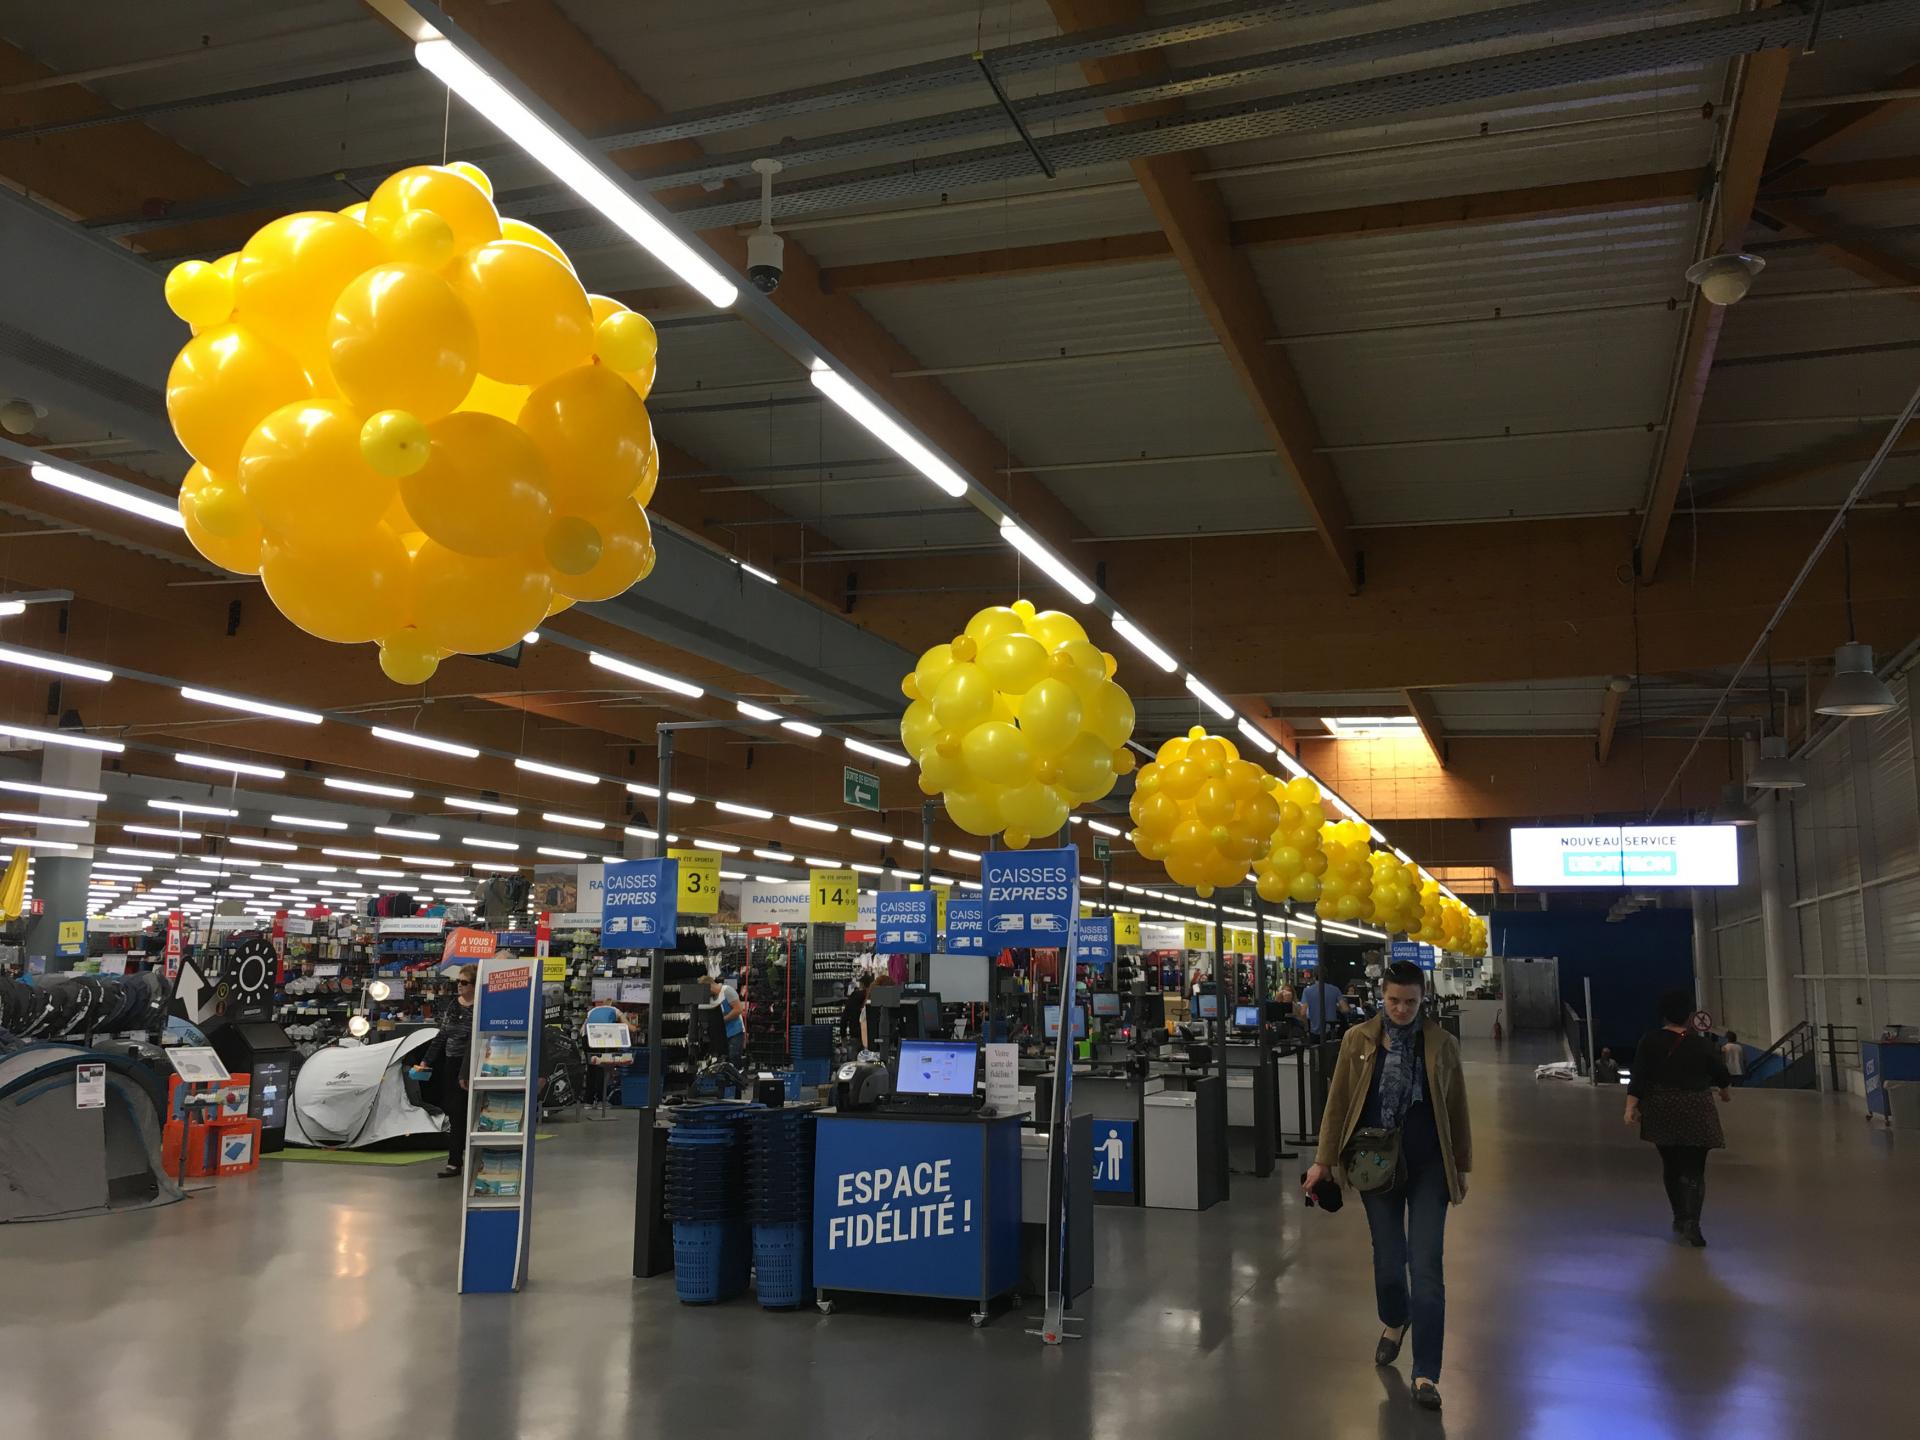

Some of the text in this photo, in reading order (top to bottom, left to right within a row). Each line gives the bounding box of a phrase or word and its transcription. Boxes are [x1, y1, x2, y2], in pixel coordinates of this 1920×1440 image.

[1561, 835, 1677, 846] NOUVEAU SERVICE
[989, 867, 1067, 883] CAISSES
[607, 874, 657, 889] CAISSES
[687, 872, 701, 893] 3
[606, 891, 657, 906] EXPRESS
[752, 894, 810, 904] RANDONNÉE
[819, 887, 843, 905] 14
[988, 886, 1068, 901] EXPRESS
[880, 901, 926, 912] CAISSES
[879, 913, 927, 923] EXPRESS
[950, 910, 983, 920] CAISS
[461, 936, 467, 945] A
[469, 937, 489, 946] VOUS
[1188, 931, 1200, 941] 19
[1237, 937, 1247, 947] 19
[470, 946, 492, 954] TESTER
[837, 1159, 951, 1207] ESPACE
[829, 1194, 971, 1250] FIDÉLITÉ !
